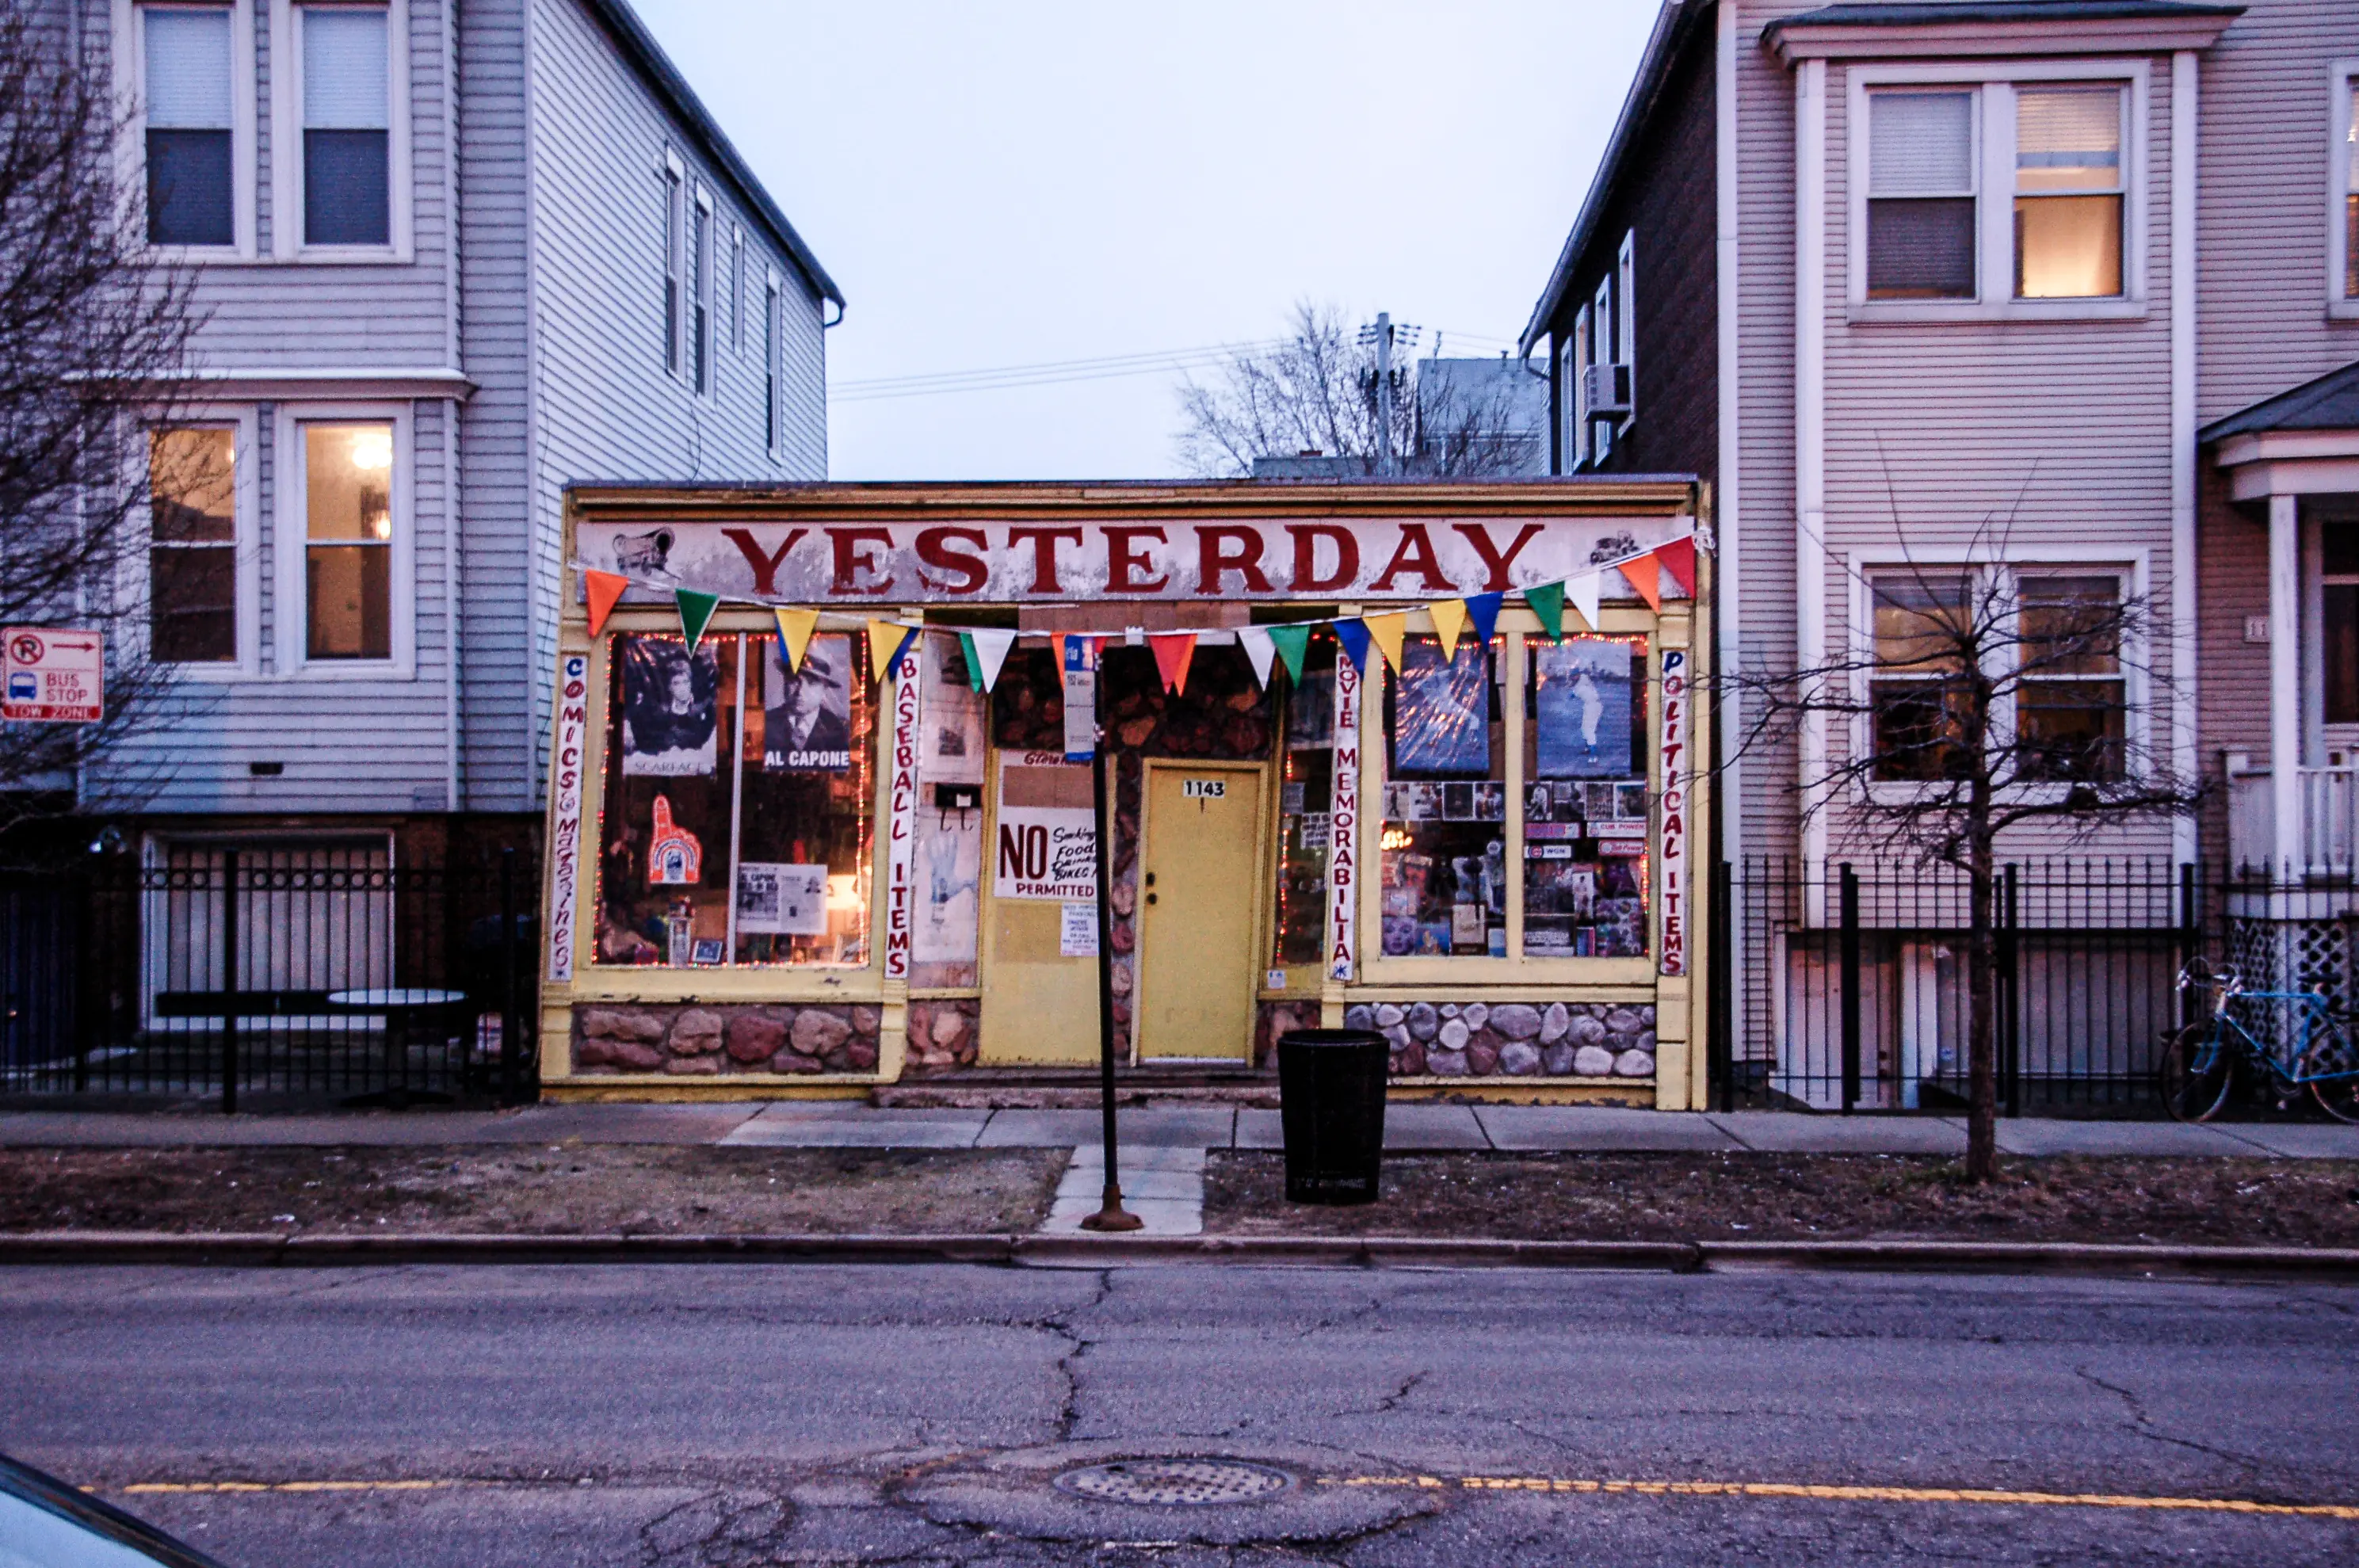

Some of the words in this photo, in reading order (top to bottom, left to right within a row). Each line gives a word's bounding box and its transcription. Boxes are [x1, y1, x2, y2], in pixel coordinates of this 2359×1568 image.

[720, 523, 1545, 596] YESTERDAY
[46, 673, 80, 688] BUS
[47, 689, 88, 702] STOP
[1339, 655, 1356, 728] MOVIE
[765, 750, 784, 766] AL
[788, 751, 849, 766] CAPONE
[892, 658, 917, 841] BASEBALL
[1662, 652, 1683, 860] POLITICAL
[1185, 780, 1224, 796] 1143
[999, 823, 1048, 880] NO
[1333, 748, 1356, 961] MEMORABILIA
[888, 862, 909, 974] ITEMS
[1016, 881, 1095, 898] PERMITTED
[1664, 872, 1683, 973] ITEMS
